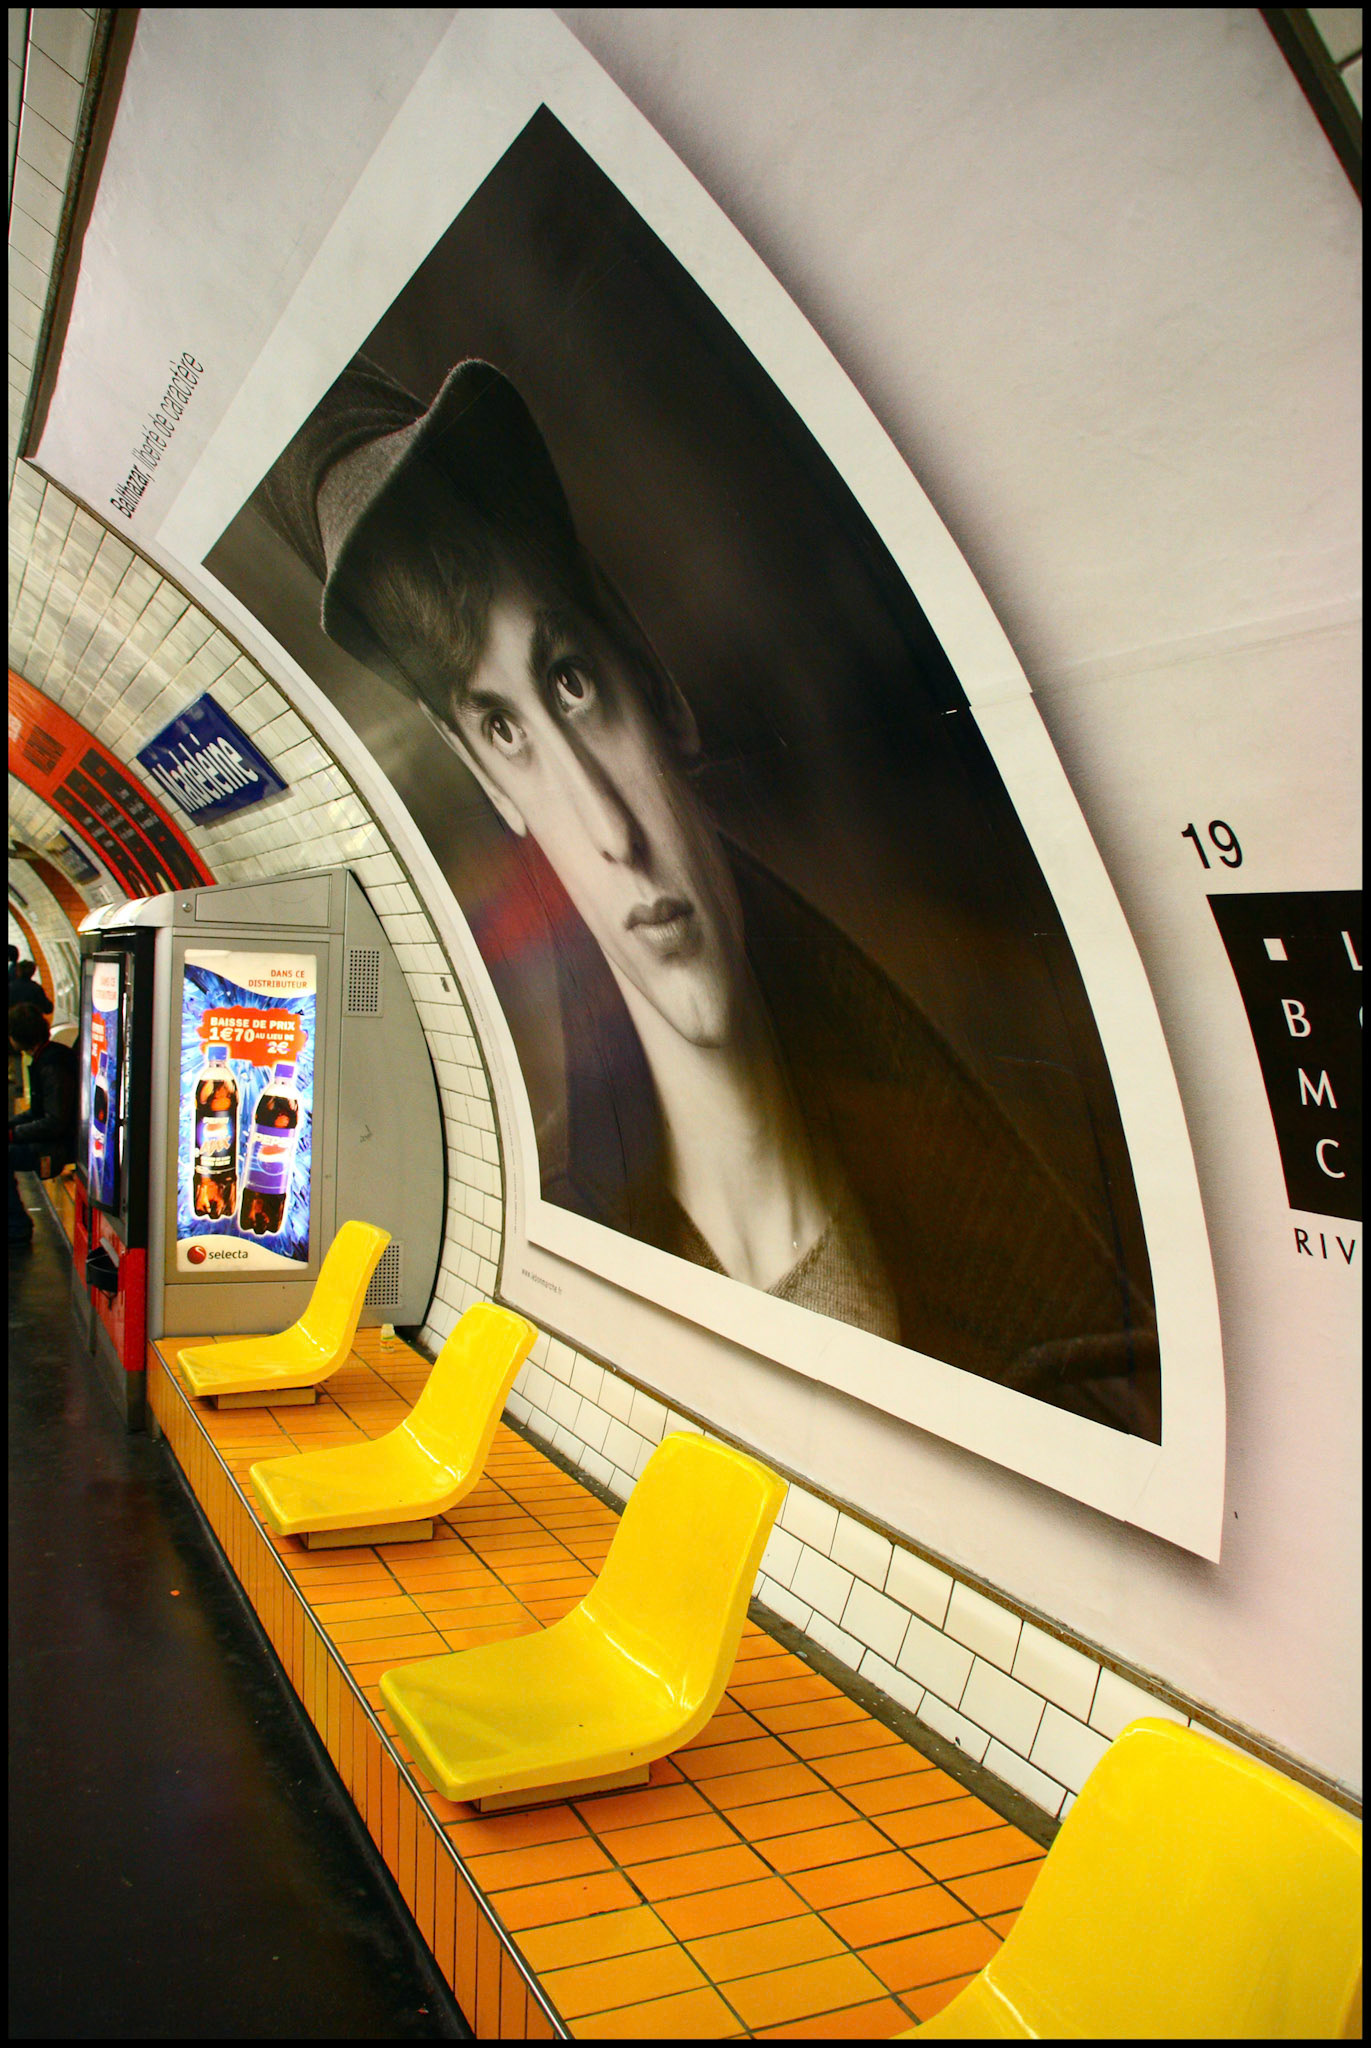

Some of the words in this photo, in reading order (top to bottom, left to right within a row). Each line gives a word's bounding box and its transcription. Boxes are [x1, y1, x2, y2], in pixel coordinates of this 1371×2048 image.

[160, 351, 204, 422] caractère
[147, 412, 175, 439] de
[131, 424, 168, 473] liberté
[109, 463, 156, 520] Balthazar,
[150, 733, 259, 814] Madeleine
[1181, 819, 1244, 869] 19
[248, 979, 308, 989] DISTRIBUTEUR
[271, 969, 292, 979] DANS
[295, 970, 305, 979] CE
[209, 1027, 255, 1042] 1€70
[210, 1017, 250, 1028] BAISSE
[252, 1019, 267, 1029] DE
[269, 1020, 296, 1031] PRIX
[267, 1041, 290, 1055] 2€
[208, 1250, 249, 1260] selecta
[1294, 1226, 1357, 1265] RIV
